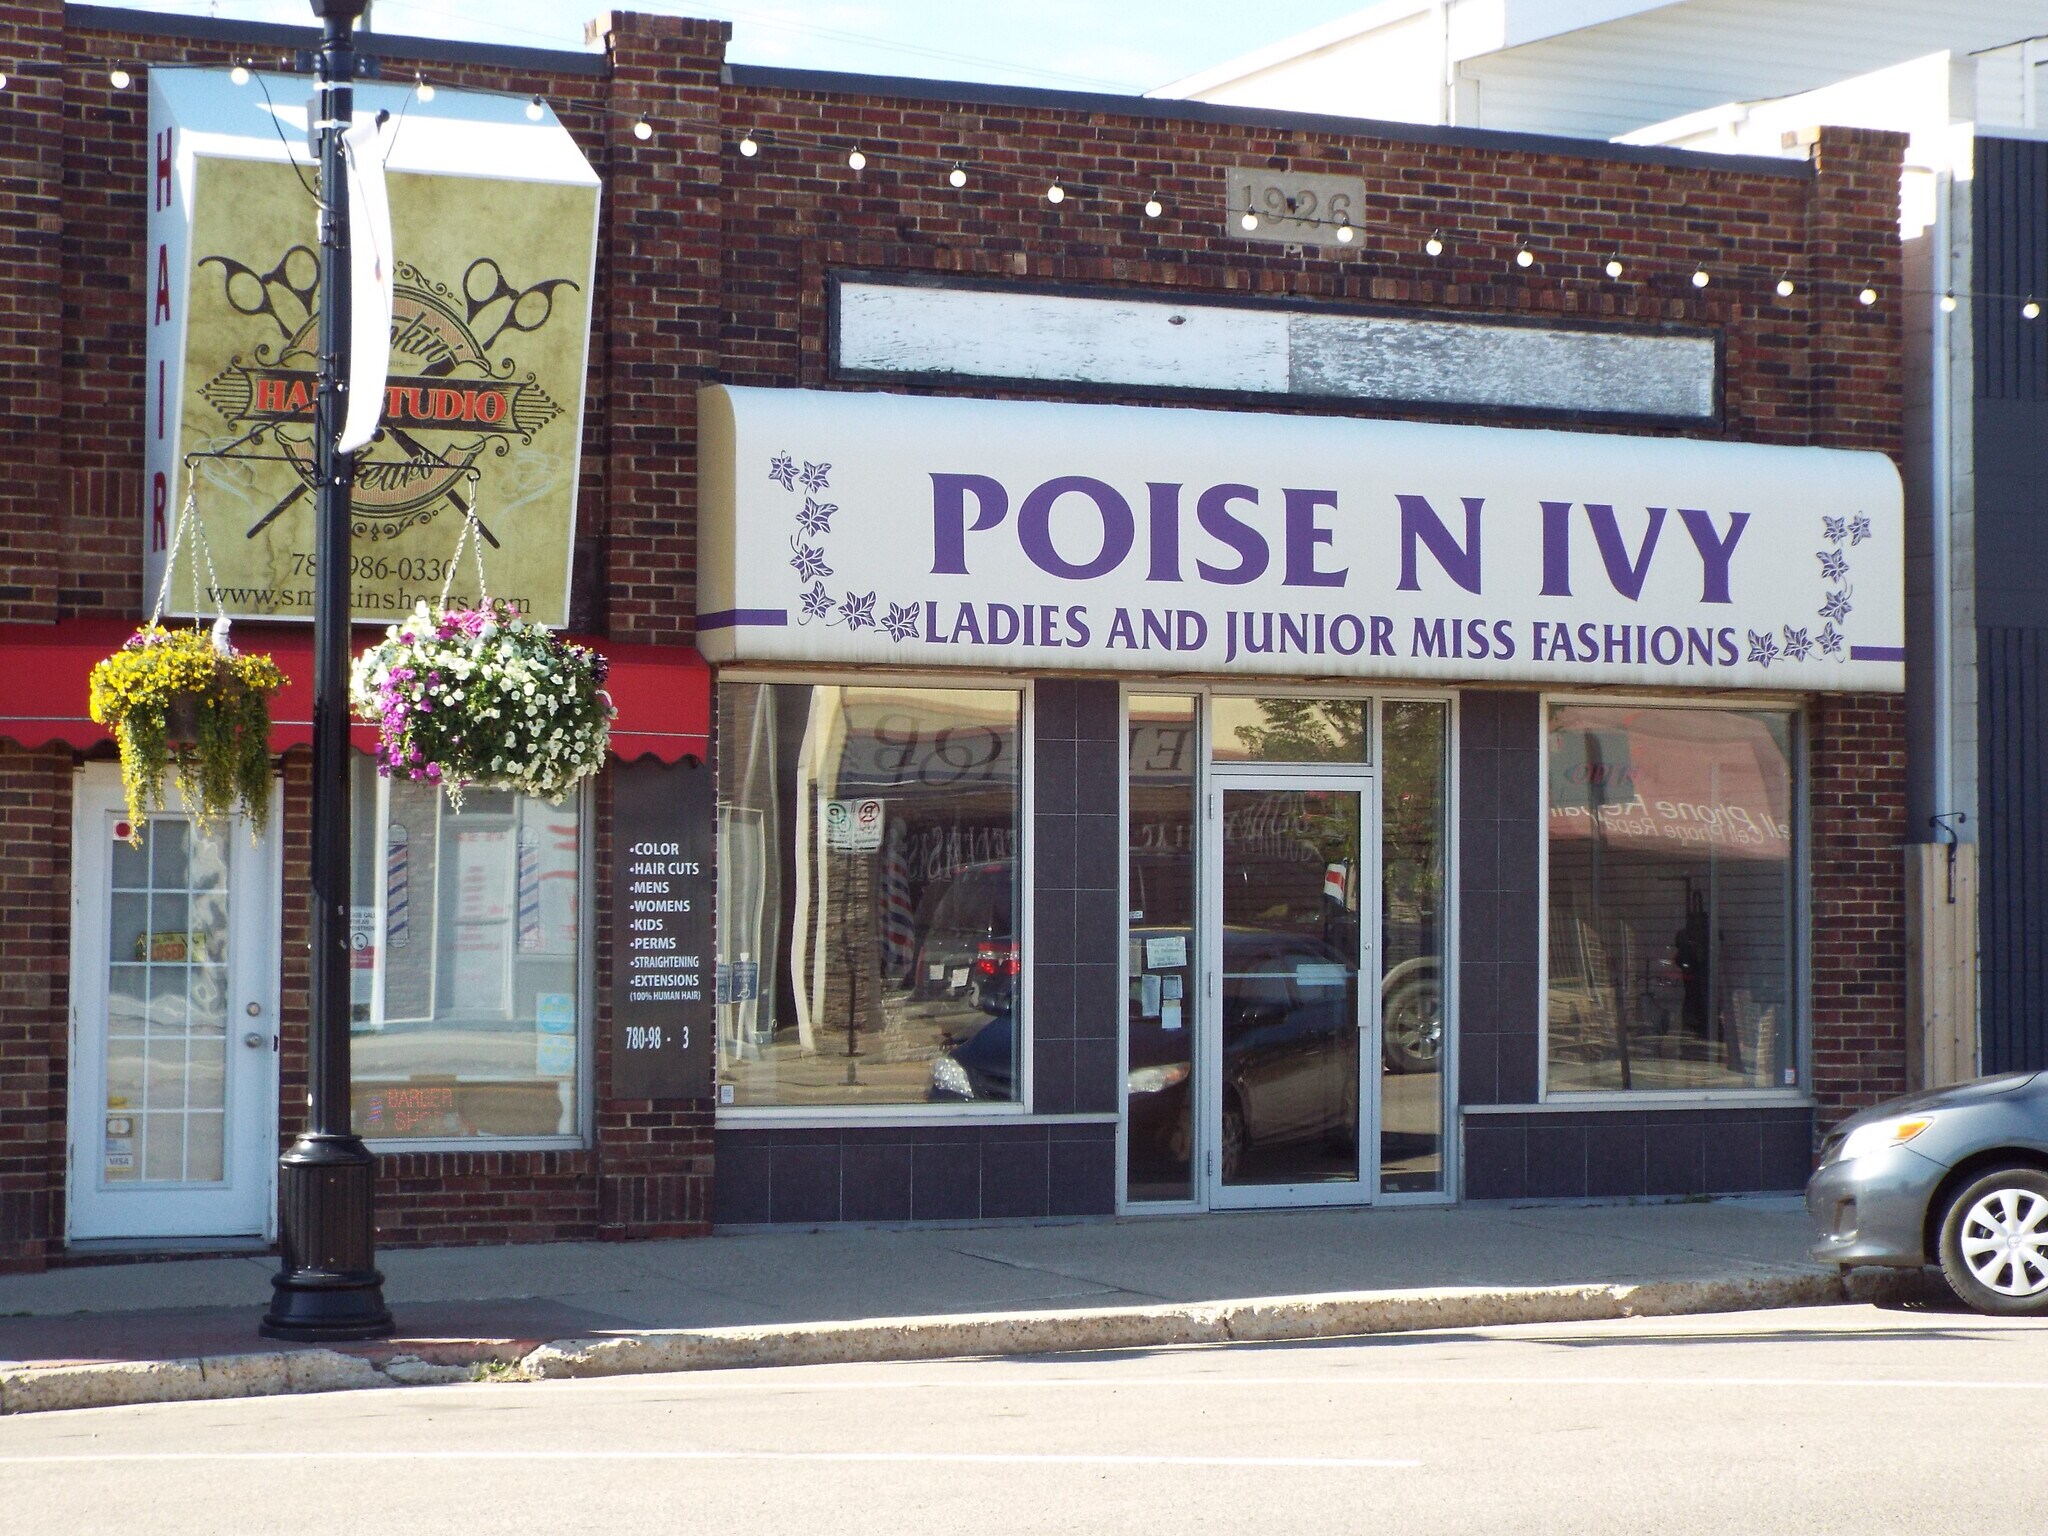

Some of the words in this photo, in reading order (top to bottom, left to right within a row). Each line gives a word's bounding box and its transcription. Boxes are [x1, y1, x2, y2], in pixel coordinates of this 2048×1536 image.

[1242, 185, 1352, 229] 1926
[152, 127, 173, 554] HAIR
[385, 386, 507, 423] TUDIO
[928, 472, 1349, 588] POISE
[1395, 494, 1485, 595] N
[1538, 501, 1751, 604] IVY
[292, 553, 455, 582] 78986-0330
[925, 601, 1090, 648] LADIES
[1105, 608, 1208, 652] AND
[1224, 611, 1397, 664] JUNIOR
[1411, 617, 1515, 661] MISS
[1532, 621, 1740, 667] FASHIONS
[634, 842, 680, 856] COLOR
[634, 862, 666, 875] HAIR
[668, 862, 700, 875] CUTS
[634, 881, 670, 894] MENS
[634, 900, 691, 912] WOMENS
[634, 918, 664, 931] KIDS
[634, 937, 677, 949] PERMS
[634, 955, 699, 969] STRAIGHTENING
[634, 974, 699, 987] EXTENSIONS
[629, 990, 653, 1002] (100%
[653, 990, 680, 1001] HUMAN
[681, 990, 701, 1002] HAIR)
[109, 1157, 129, 1166] VISA
